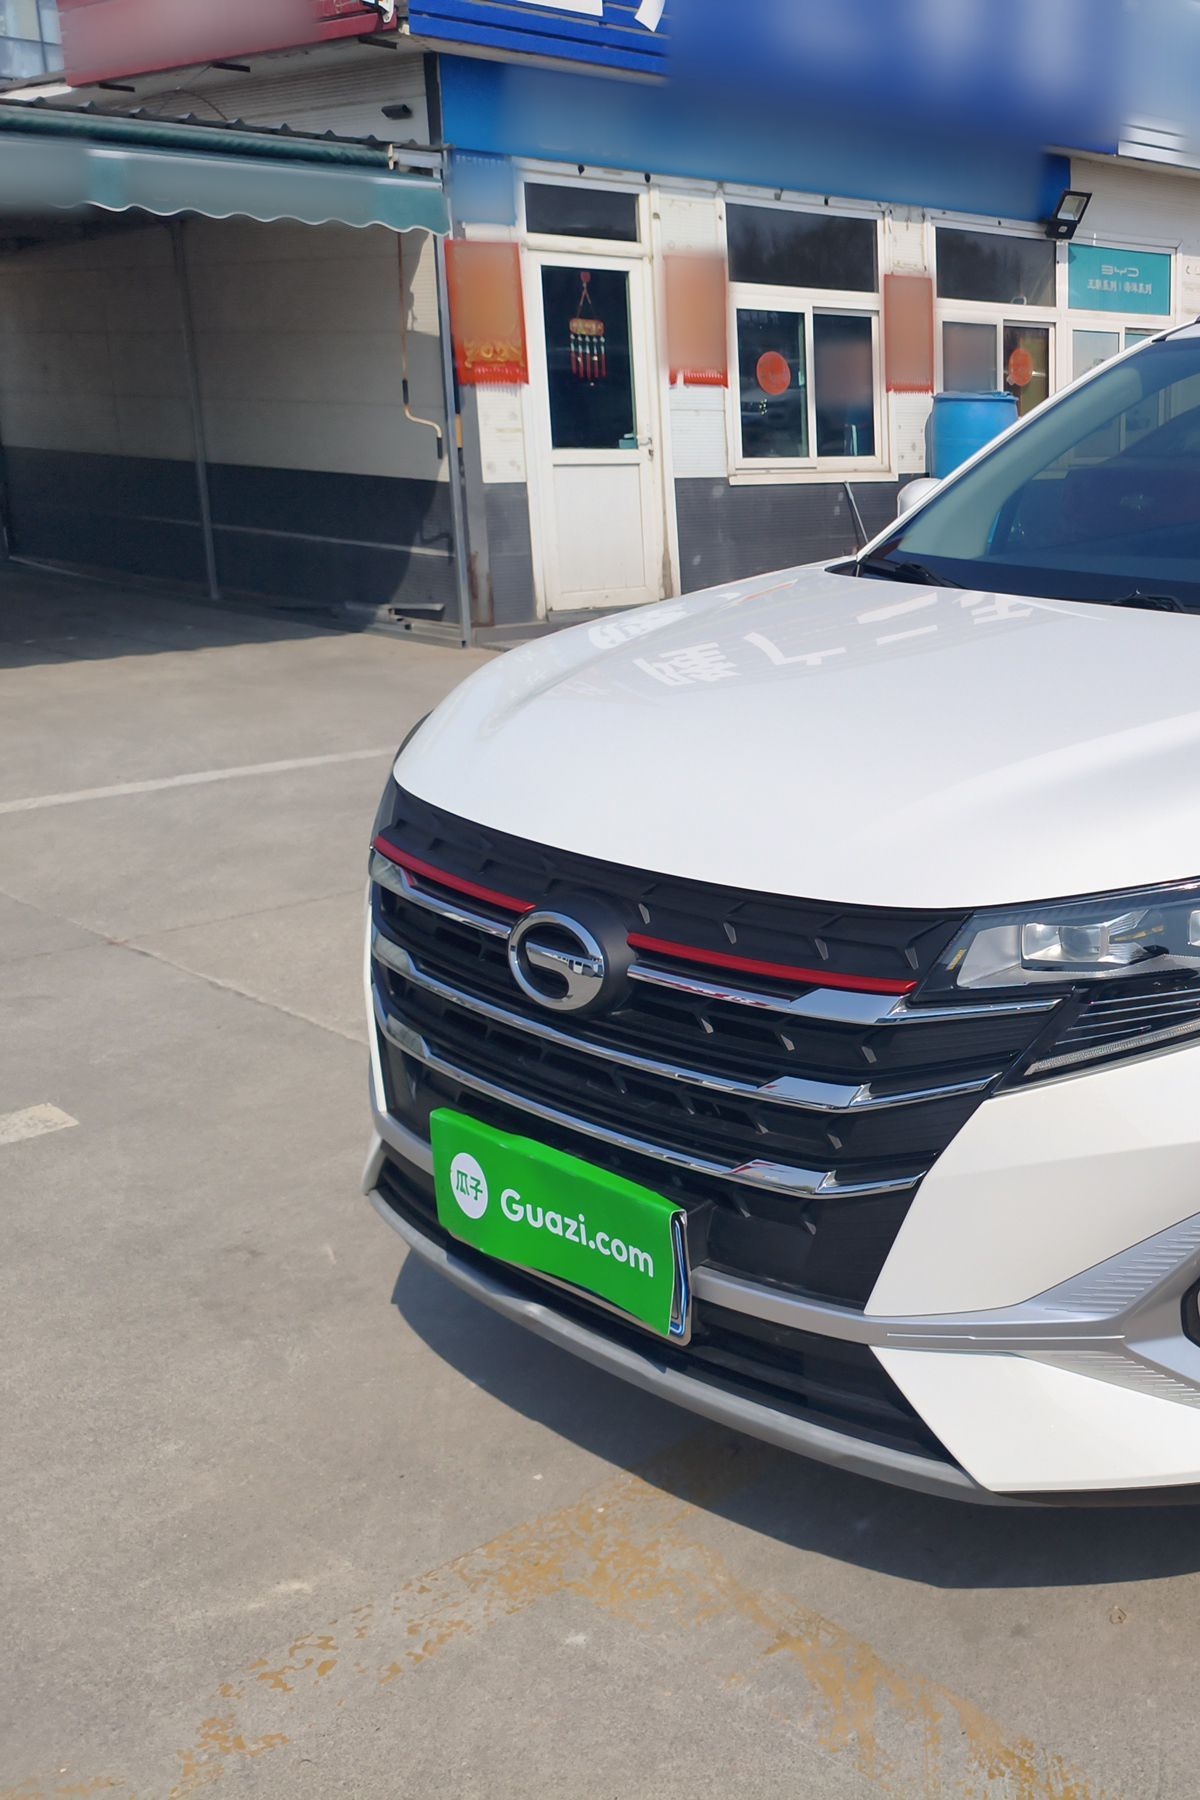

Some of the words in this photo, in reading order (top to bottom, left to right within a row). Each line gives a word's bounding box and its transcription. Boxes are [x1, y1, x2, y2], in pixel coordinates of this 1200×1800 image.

[1101, 264, 1139, 277] BYD
[456, 1170, 483, 1200] 瓜子
[501, 1189, 654, 1278] Guazi.com
